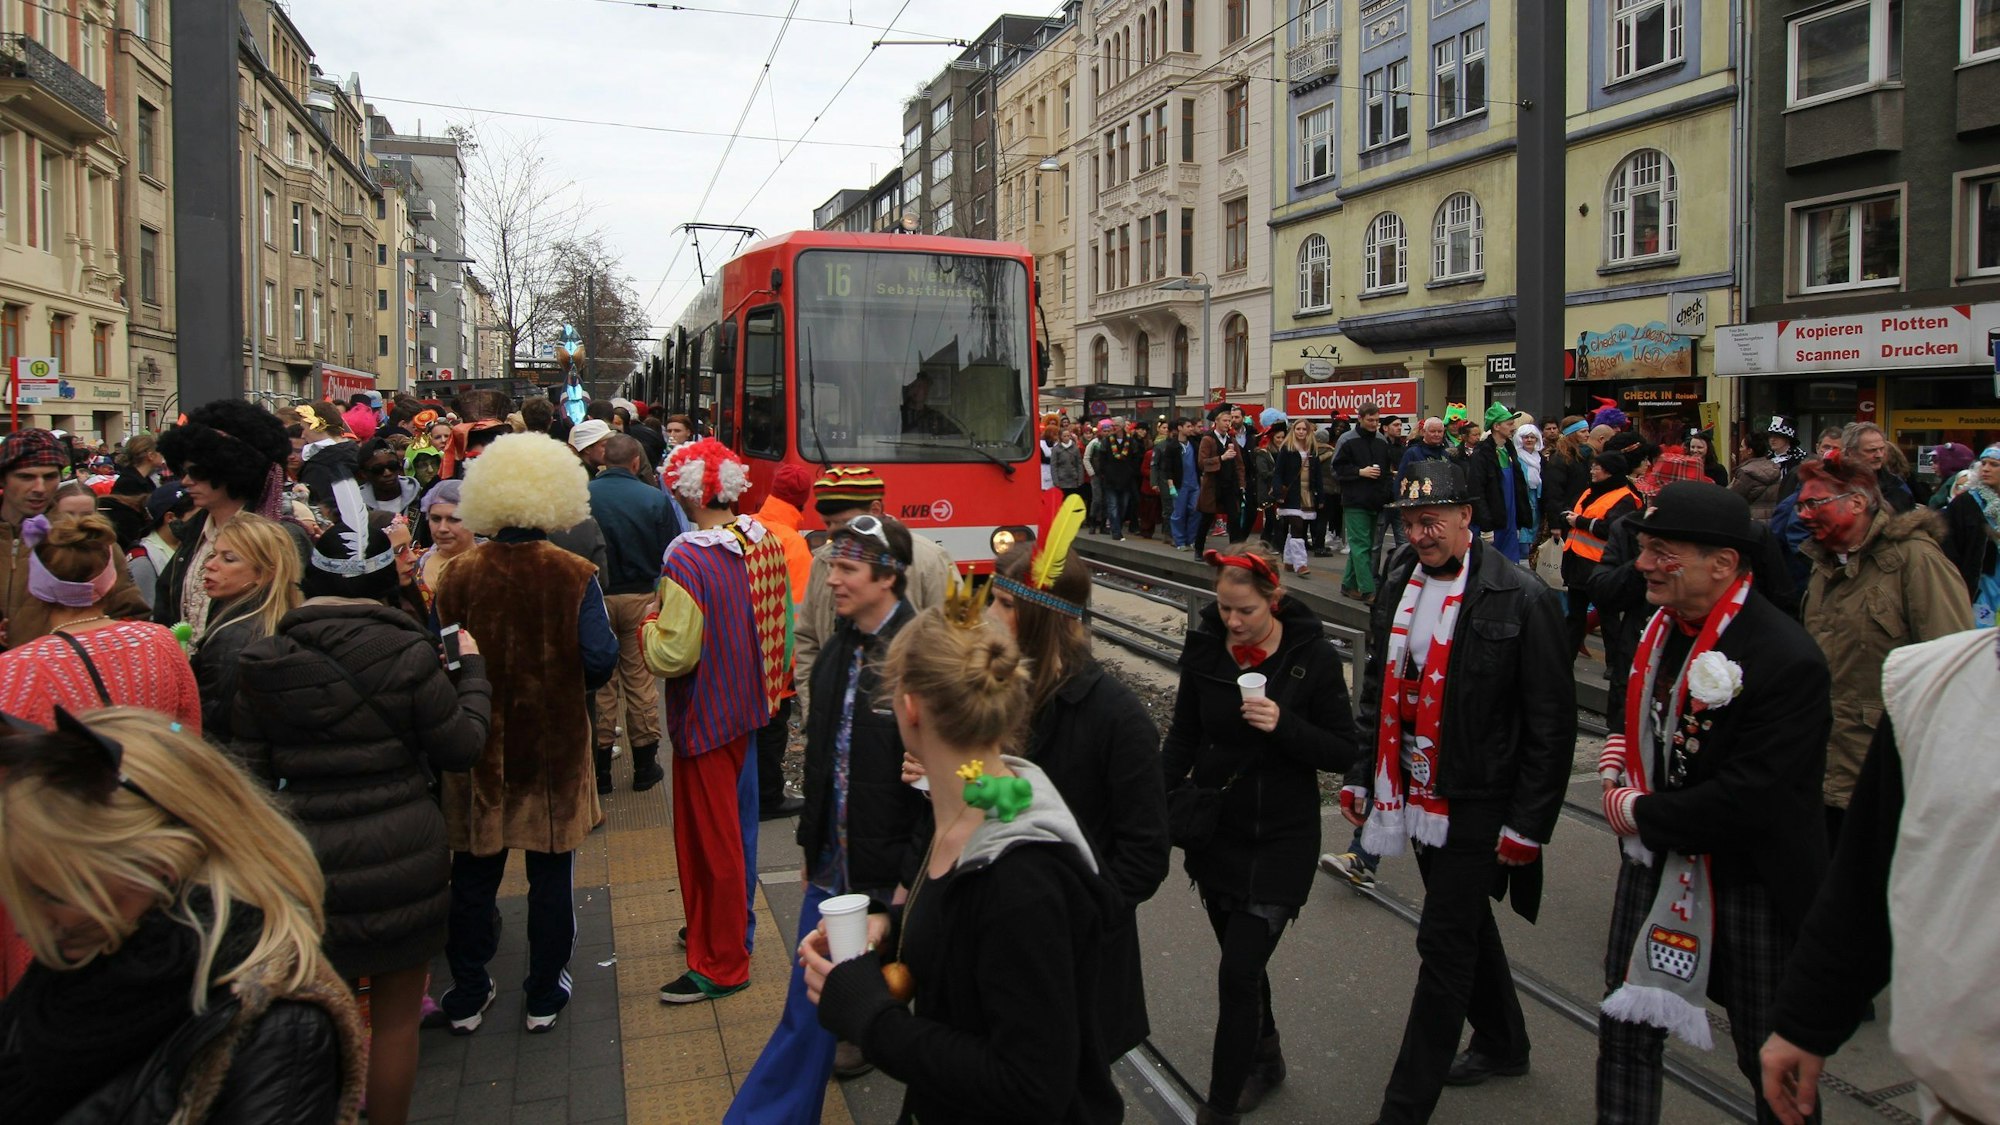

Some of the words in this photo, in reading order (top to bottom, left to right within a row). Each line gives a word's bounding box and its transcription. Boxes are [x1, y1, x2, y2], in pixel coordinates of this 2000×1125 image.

[825, 262, 851, 297] 16
[1676, 297, 1703, 323] check
[1695, 312, 1704, 326] in
[1881, 316, 1948, 332] Plotten
[1795, 324, 1863, 341] Kopieren
[1796, 348, 1860, 362] Scannen
[1881, 342, 1958, 358] Drucken
[35, 363, 45, 374] H
[1488, 357, 1516, 372] TEEL
[1623, 391, 1658, 400] CHECK
[1661, 391, 1672, 400] IN
[1860, 401, 1875, 412] C
[901, 504, 931, 518] KVB
